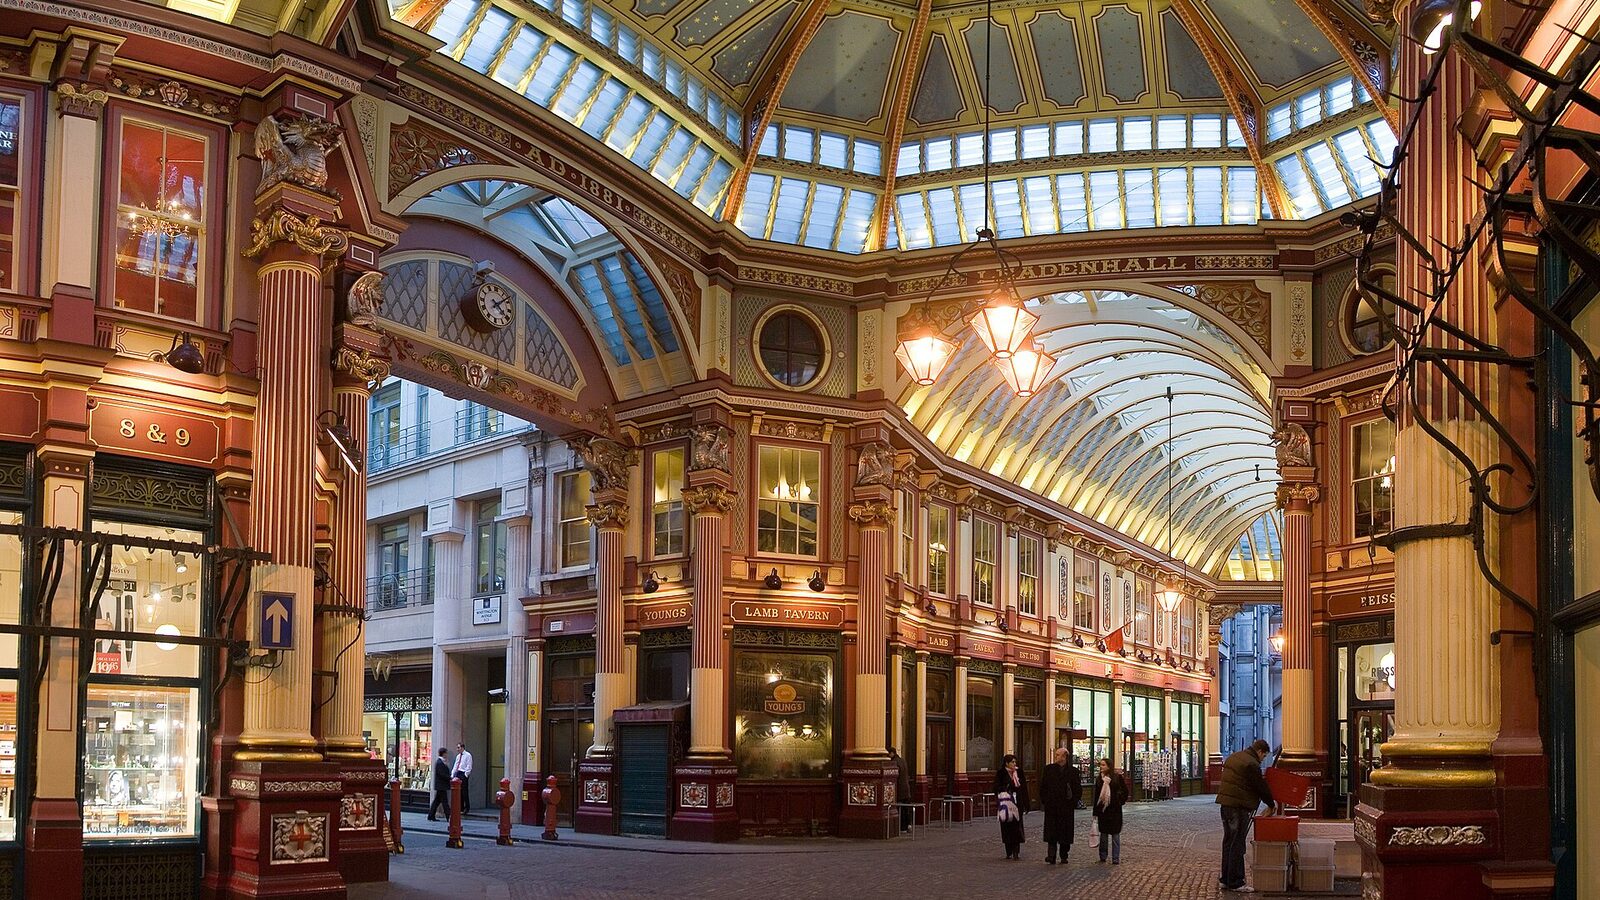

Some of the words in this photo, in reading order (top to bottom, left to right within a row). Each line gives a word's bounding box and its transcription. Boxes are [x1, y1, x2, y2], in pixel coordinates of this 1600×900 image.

[580, 174, 624, 212] 1881
[977, 256, 1187, 284] LEADENHALL
[120, 418, 136, 438] 8
[146, 423, 166, 443] &
[175, 428, 191, 446] 9
[645, 607, 688, 621] YOUNGS
[745, 607, 779, 618] LAMB
[784, 608, 830, 621] TAVERN
[929, 636, 949, 647] LAMB
[973, 643, 996, 654] TAVERN
